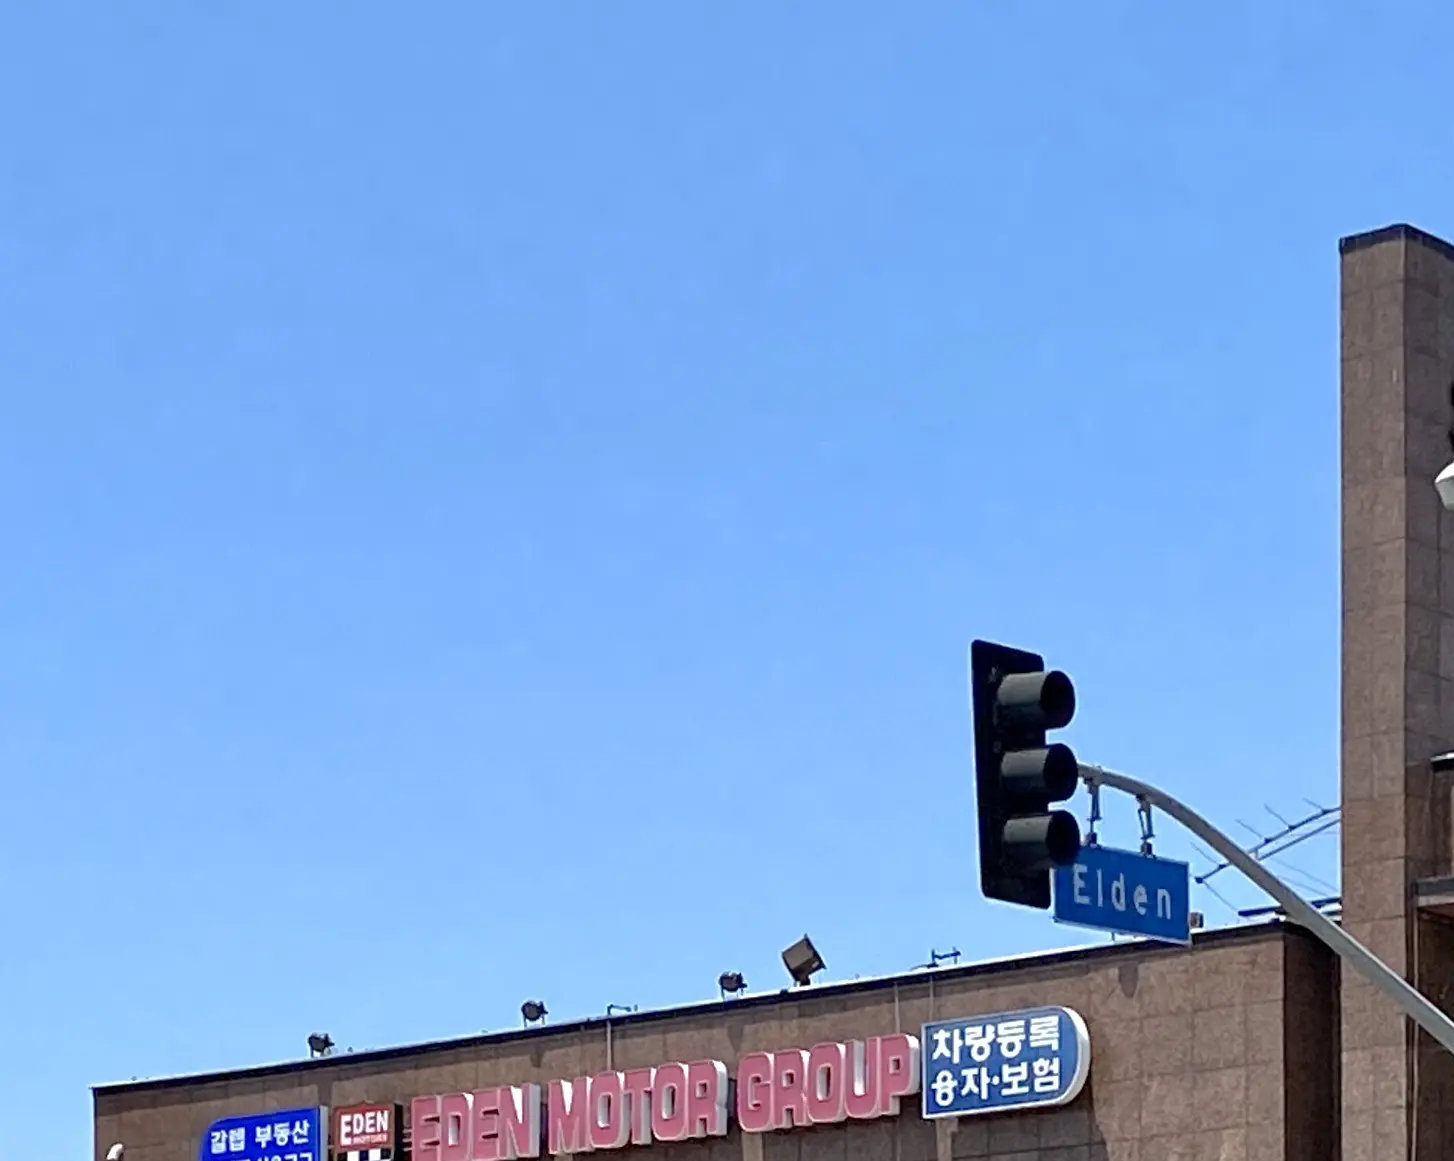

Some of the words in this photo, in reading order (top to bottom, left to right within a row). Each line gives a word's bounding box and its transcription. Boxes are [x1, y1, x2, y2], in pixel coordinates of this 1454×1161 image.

[1073, 863, 1171, 920] Elden
[932, 1015, 1060, 1064] 차량등록
[548, 1060, 727, 1155] MOTOR
[737, 1033, 920, 1133] GROUP
[255, 1119, 310, 1149] 부동산
[341, 1110, 389, 1146] EDEN
